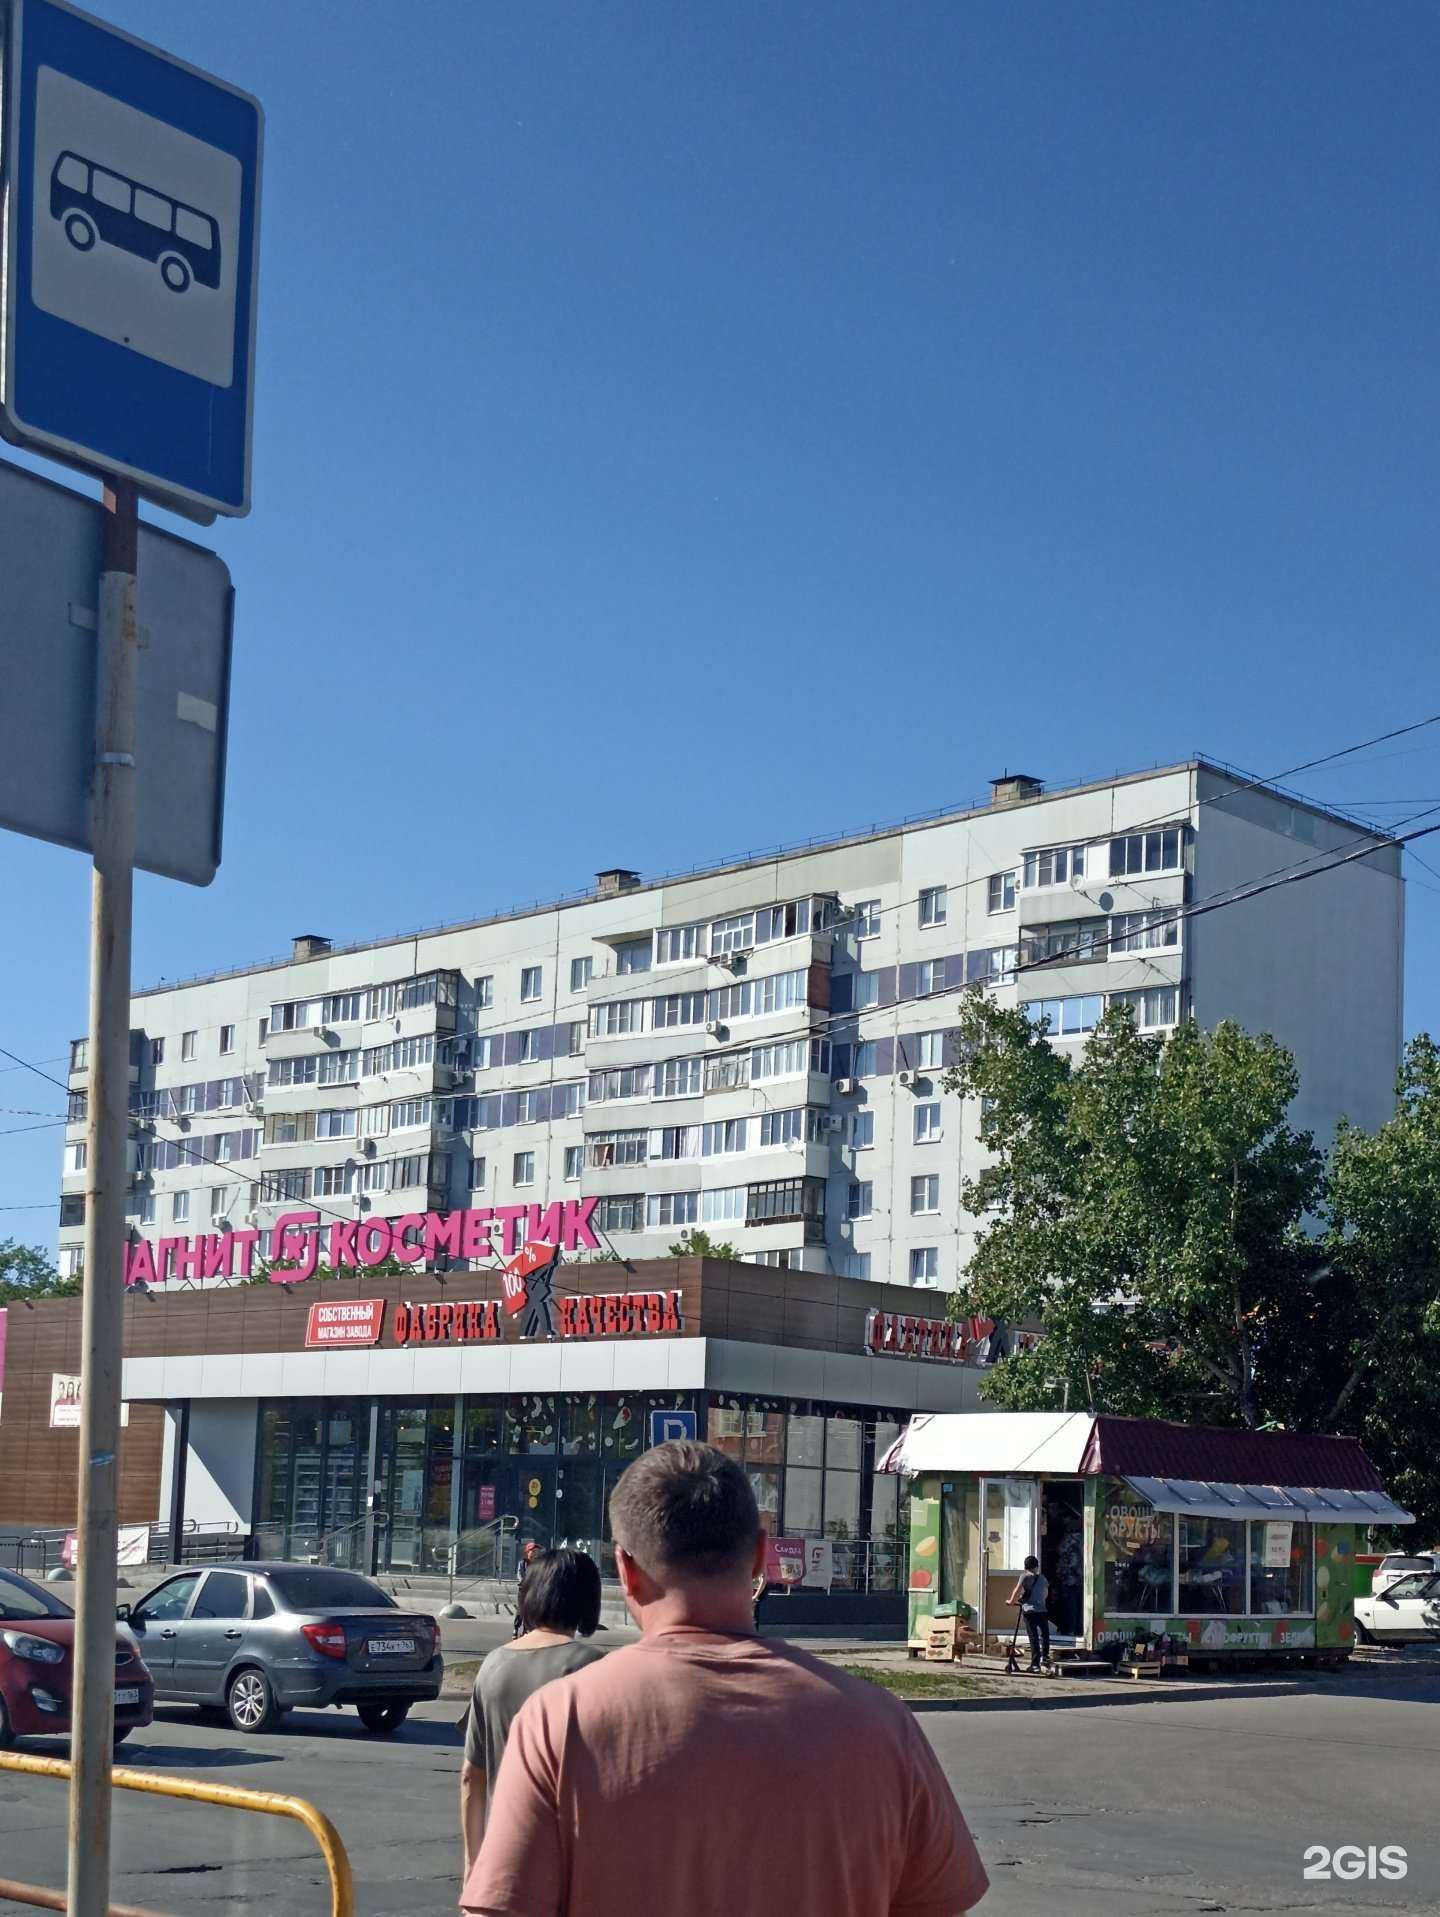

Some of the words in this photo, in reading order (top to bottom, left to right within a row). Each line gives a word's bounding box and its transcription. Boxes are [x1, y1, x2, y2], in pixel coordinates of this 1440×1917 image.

[124, 1230, 260, 1285] АГНИТ
[329, 1197, 601, 1270] КОСМЕТИК
[317, 1302, 375, 1322] СОБСТВЕННЫЙ
[393, 1300, 502, 1346] ФАБРИКА
[560, 1290, 683, 1337] КАЧЕСТВА
[317, 1326, 346, 1340] МАГАЗИН
[346, 1324, 373, 1338] ЗАВОДА
